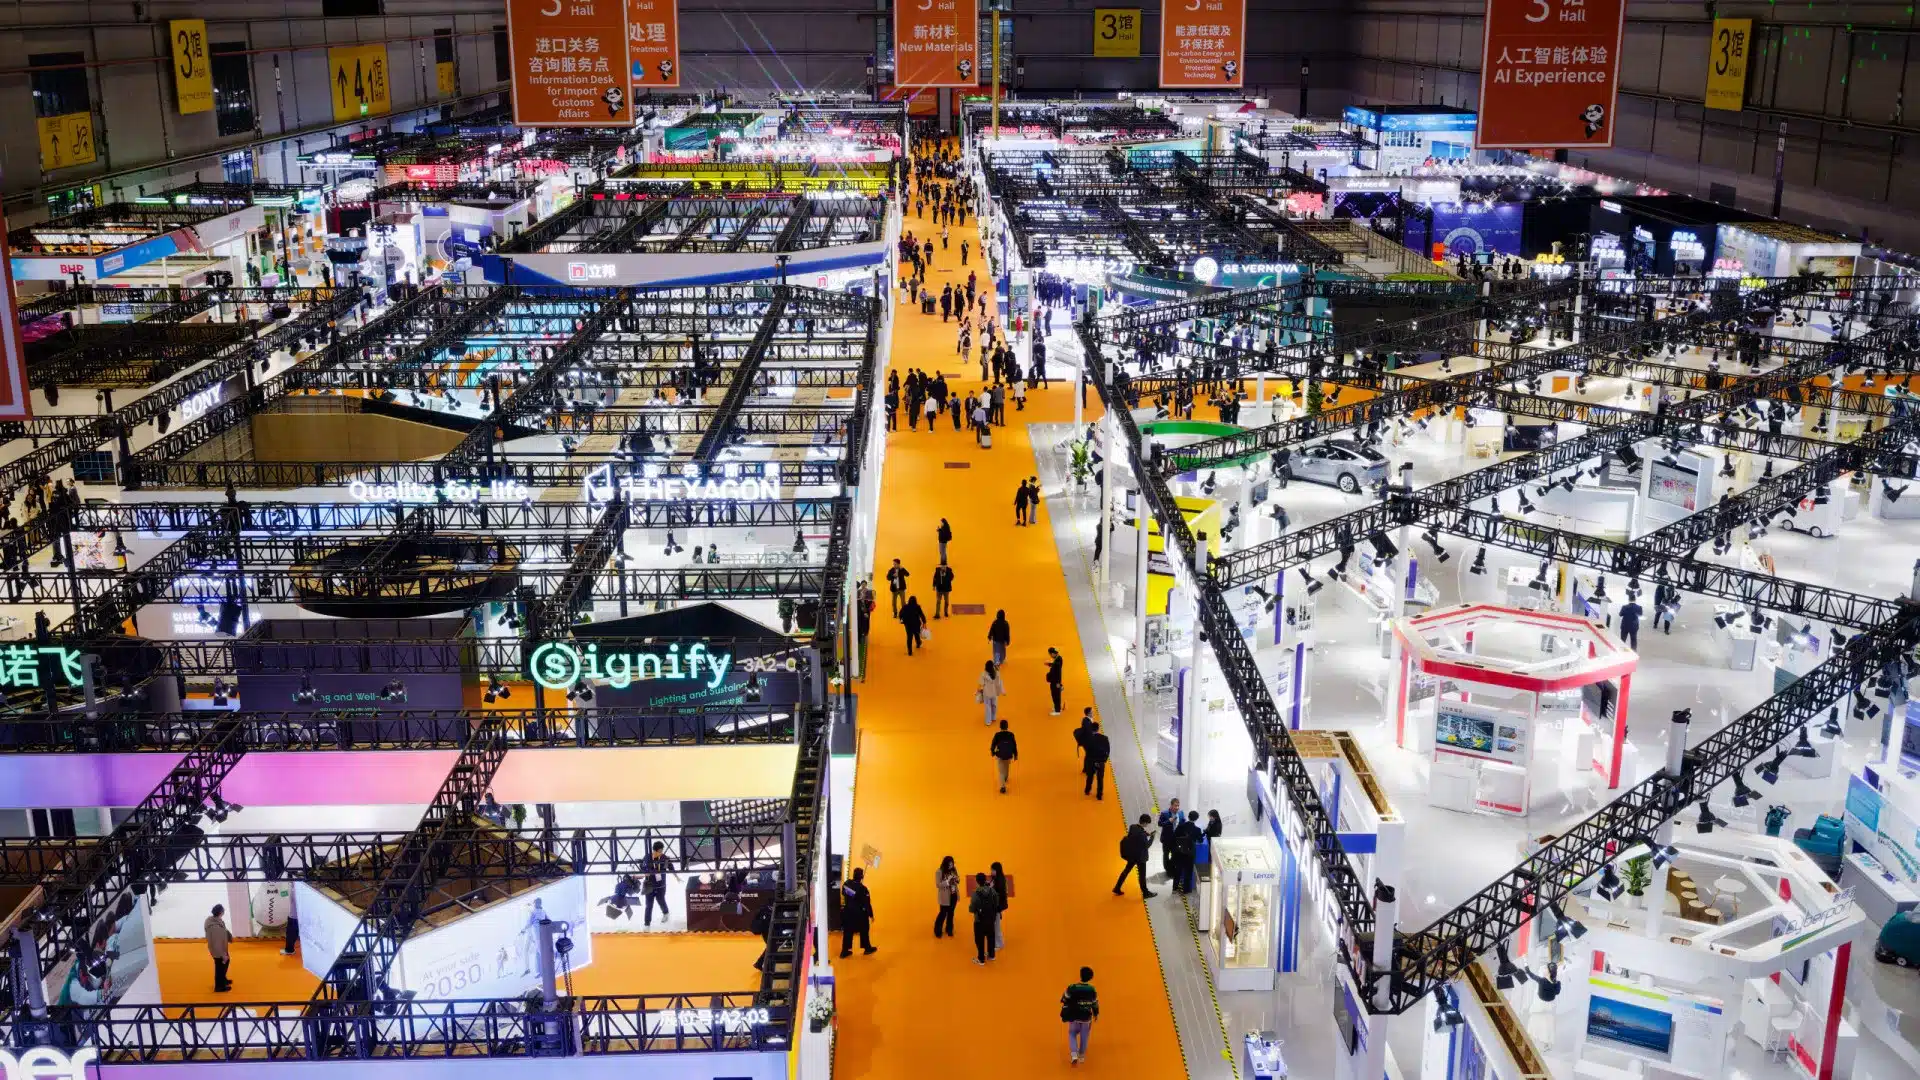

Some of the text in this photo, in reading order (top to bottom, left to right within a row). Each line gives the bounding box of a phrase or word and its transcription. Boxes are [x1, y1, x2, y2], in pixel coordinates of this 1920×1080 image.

[570, 5, 595, 16] Hall
[636, 2, 654, 10] Hall
[938, 2, 955, 10] Hall
[1206, 3, 1223, 11] Hall
[1559, 10, 1586, 22] Hall
[629, 22, 666, 42] 处理
[913, 24, 956, 40] 新材料
[1101, 14, 1134, 40] 3 馆
[1175, 25, 1231, 37] 能源低碳及
[1118, 32, 1134, 41] Hall
[535, 37, 600, 53] 进口关务
[900, 42, 973, 52] New Materials
[1180, 39, 1225, 49] 环保技术
[178, 30, 203, 79] 3 馆
[1496, 46, 1608, 65] 人工智能体验
[1715, 28, 1745, 76] 3 馆
[528, 56, 610, 73] 咨询服务点
[1729, 66, 1742, 77] Hall
[529, 75, 615, 84] Information Desk
[1494, 69, 1606, 87] AI Experience
[547, 86, 598, 97] for Import
[552, 99, 595, 107] Customs
[558, 109, 590, 118] Affairs
[60, 264, 84, 274] BHP
[1222, 263, 1299, 274] GE VERNOVA
[182, 381, 223, 418] SONY
[349, 478, 529, 503] Quality for life
[645, 478, 781, 500] HEXAGON
[333, 692, 352, 701] and
[650, 692, 687, 707] Lighting
[689, 688, 707, 700] and
[424, 963, 481, 1001] 2030
